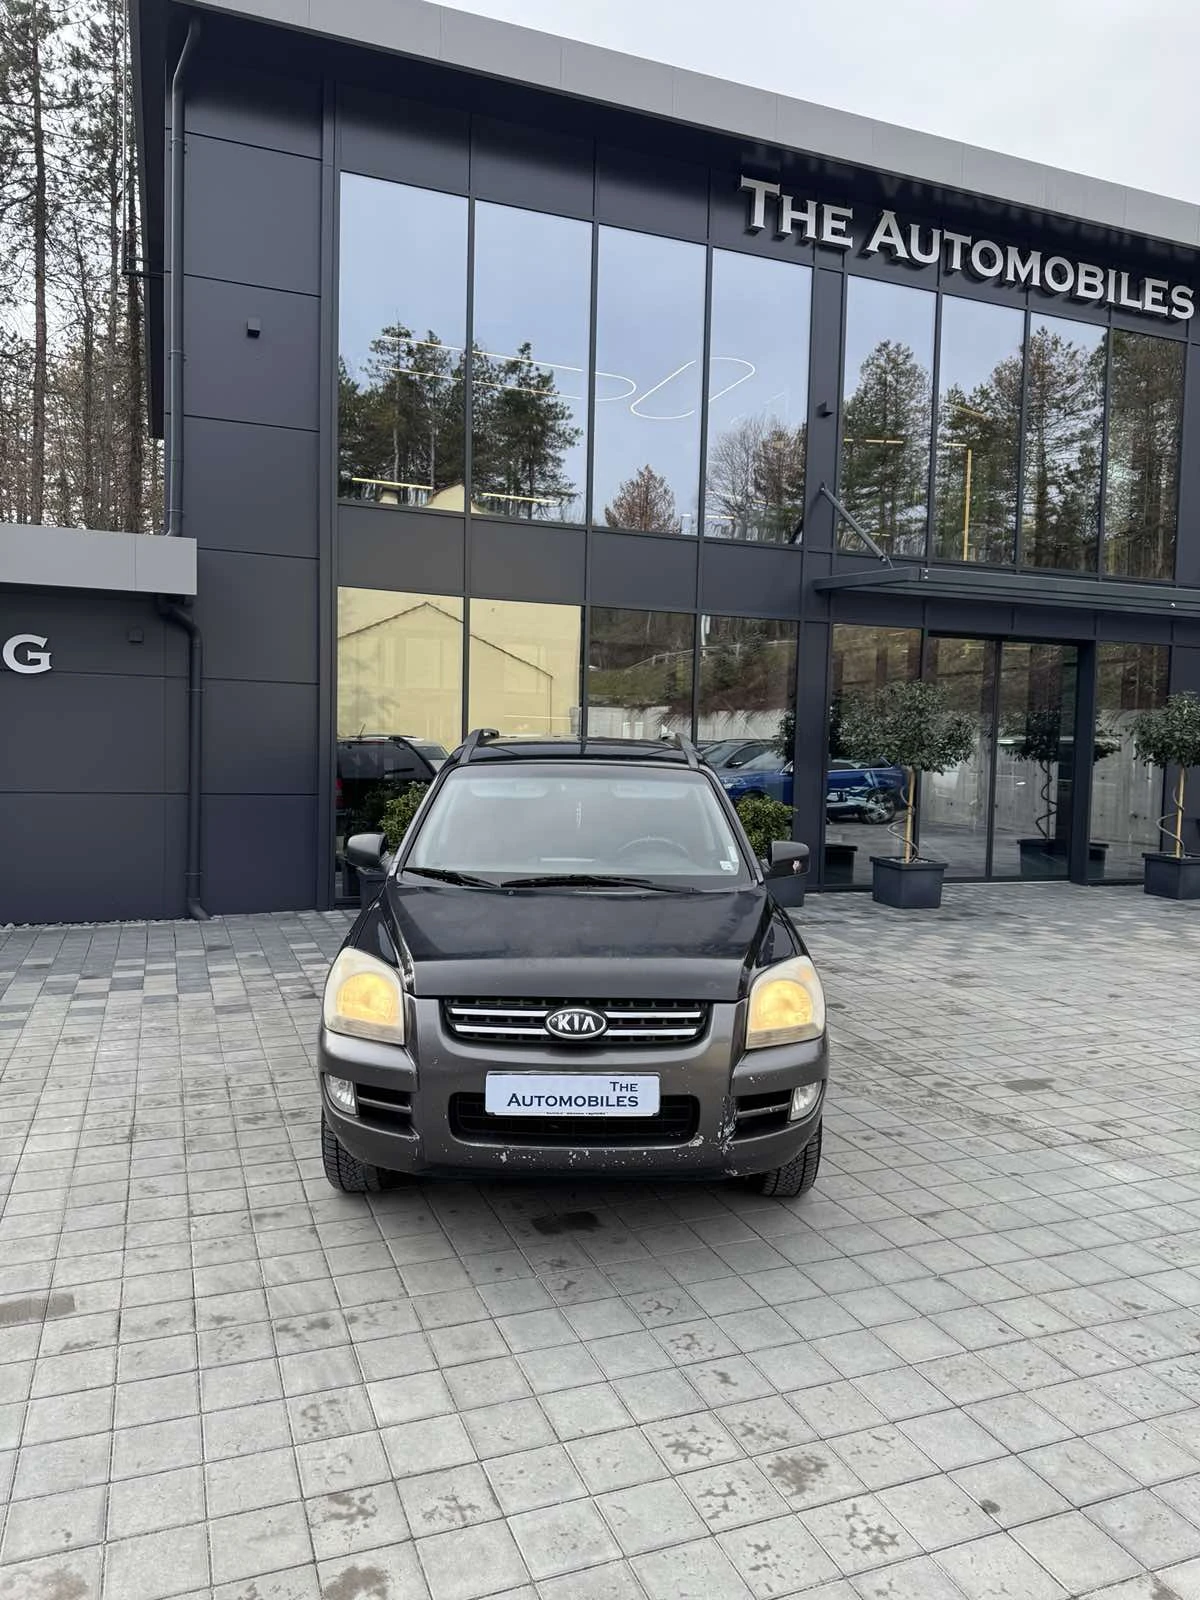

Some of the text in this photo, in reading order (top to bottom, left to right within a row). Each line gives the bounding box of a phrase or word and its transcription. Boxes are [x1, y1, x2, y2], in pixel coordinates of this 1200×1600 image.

[739, 175, 1196, 320] THE AUTOMOBILES
[2, 634, 52, 674] G
[557, 1014, 596, 1031] KIA
[609, 1081, 639, 1092] THE
[507, 1093, 639, 1108] AUTOMOBILES
